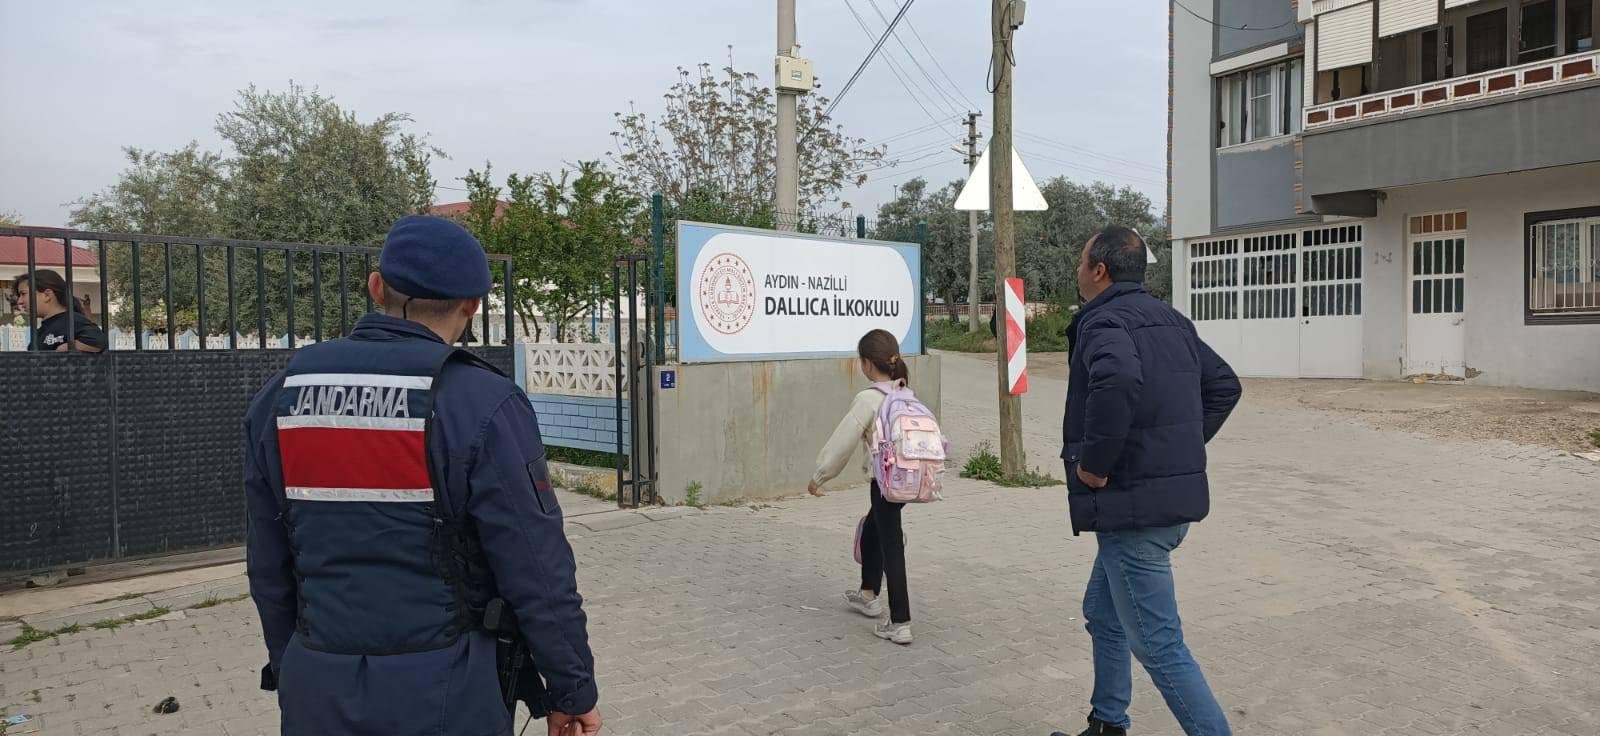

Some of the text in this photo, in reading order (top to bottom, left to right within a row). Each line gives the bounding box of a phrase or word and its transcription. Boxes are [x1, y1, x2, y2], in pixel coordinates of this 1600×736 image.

[764, 274, 799, 289] AYDIN
[808, 274, 847, 291] NAZİLLİ
[765, 294, 899, 317] DALLICA İLKOKULU
[289, 385, 410, 417] JANDARMA
